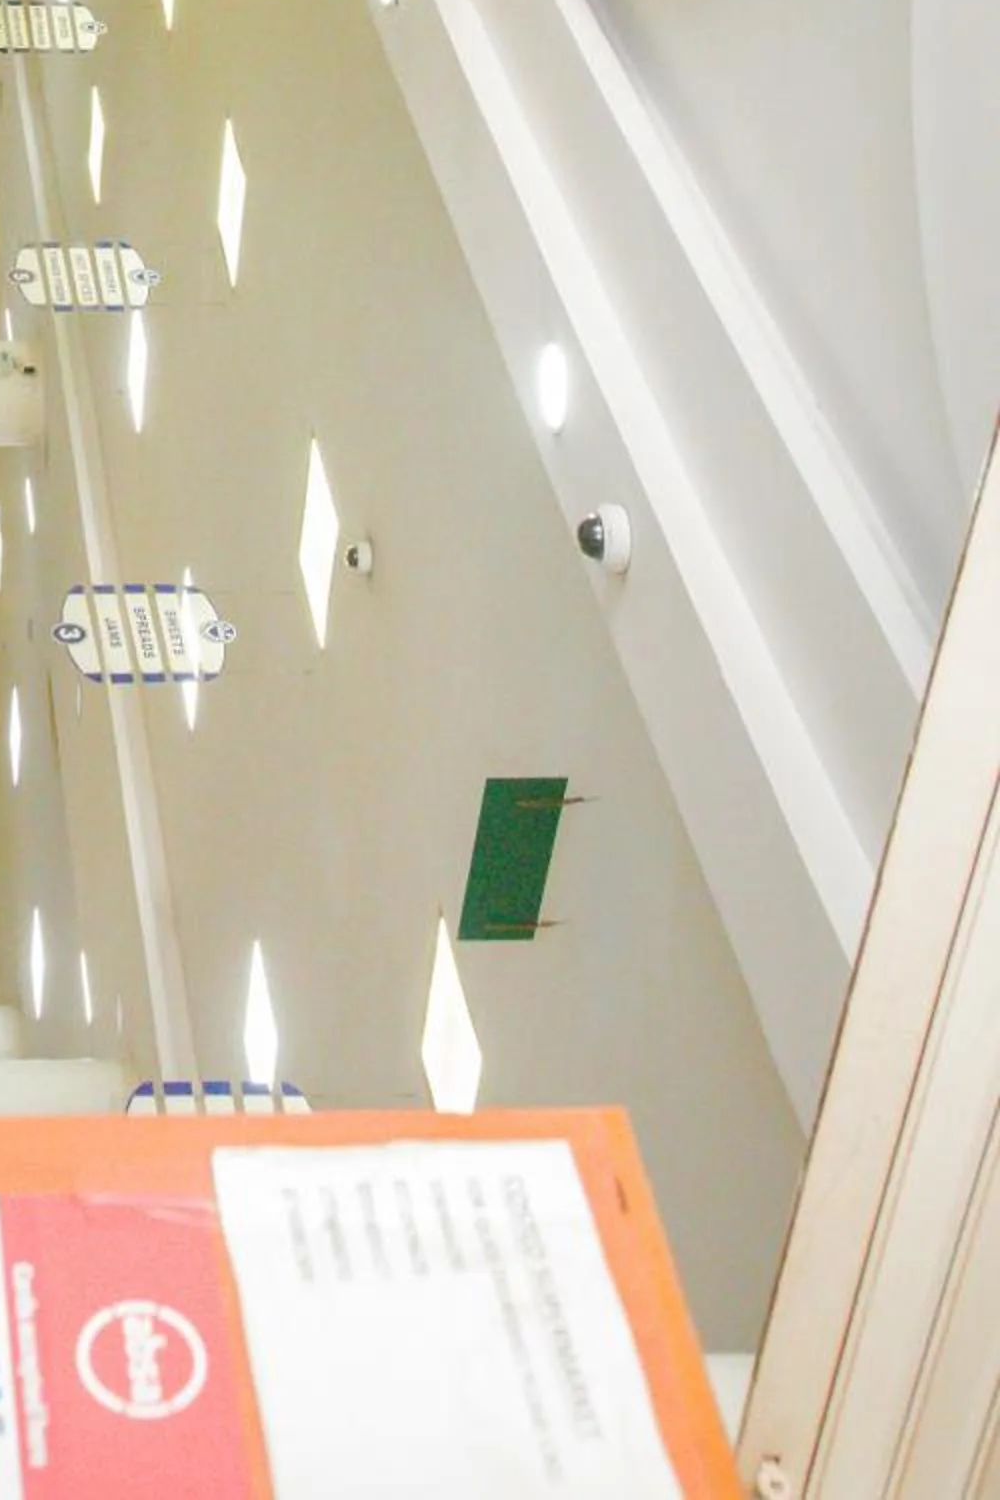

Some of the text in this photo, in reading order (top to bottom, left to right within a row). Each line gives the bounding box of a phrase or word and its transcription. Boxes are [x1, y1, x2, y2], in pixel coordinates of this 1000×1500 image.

[59, 627, 81, 639] 3
[105, 617, 122, 649] JAMS
[133, 607, 155, 659] SPREADS
[165, 610, 185, 656] SWEETS
[123, 1316, 167, 1402] absa
